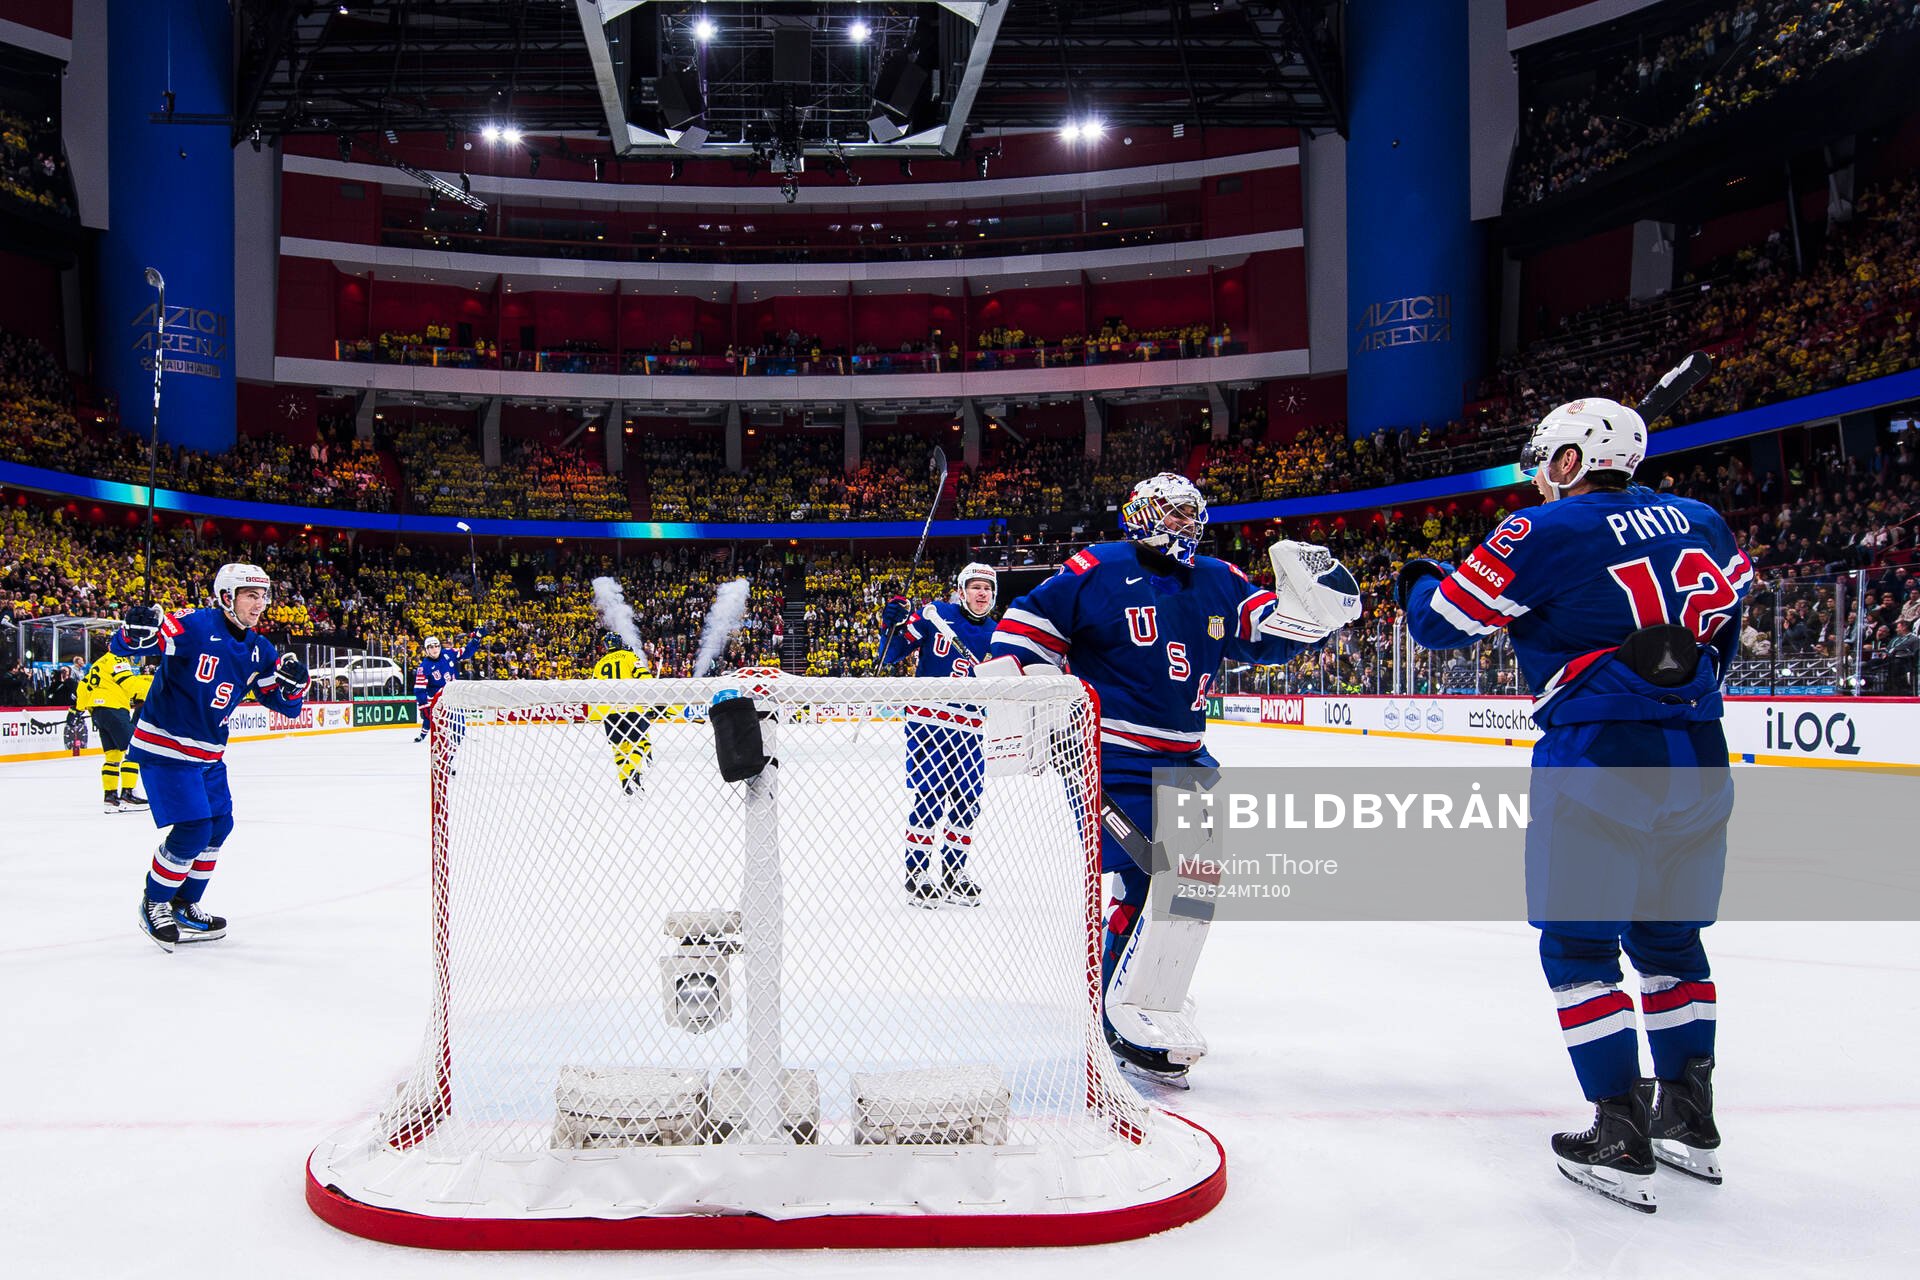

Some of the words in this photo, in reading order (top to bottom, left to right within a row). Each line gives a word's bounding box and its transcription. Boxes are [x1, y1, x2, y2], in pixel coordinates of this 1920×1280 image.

[1355, 294, 1451, 333] AVICII
[132, 331, 227, 360] ARENA
[1356, 324, 1451, 355] ARENA
[1606, 505, 1691, 545] PINTO
[1464, 553, 1505, 588] RAUSS
[1607, 548, 1739, 645] 12
[251, 645, 260, 663] A
[601, 661, 621, 679] 91
[229, 712, 267, 730] nsWorlds
[1261, 699, 1302, 723] PATRON
[1324, 701, 1352, 726] iLOQ
[20, 721, 58, 735] TISSOT
[1766, 707, 1861, 755] iLOQ
[1664, 1121, 1687, 1137] CCM
[1588, 1140, 1626, 1164] CCM
